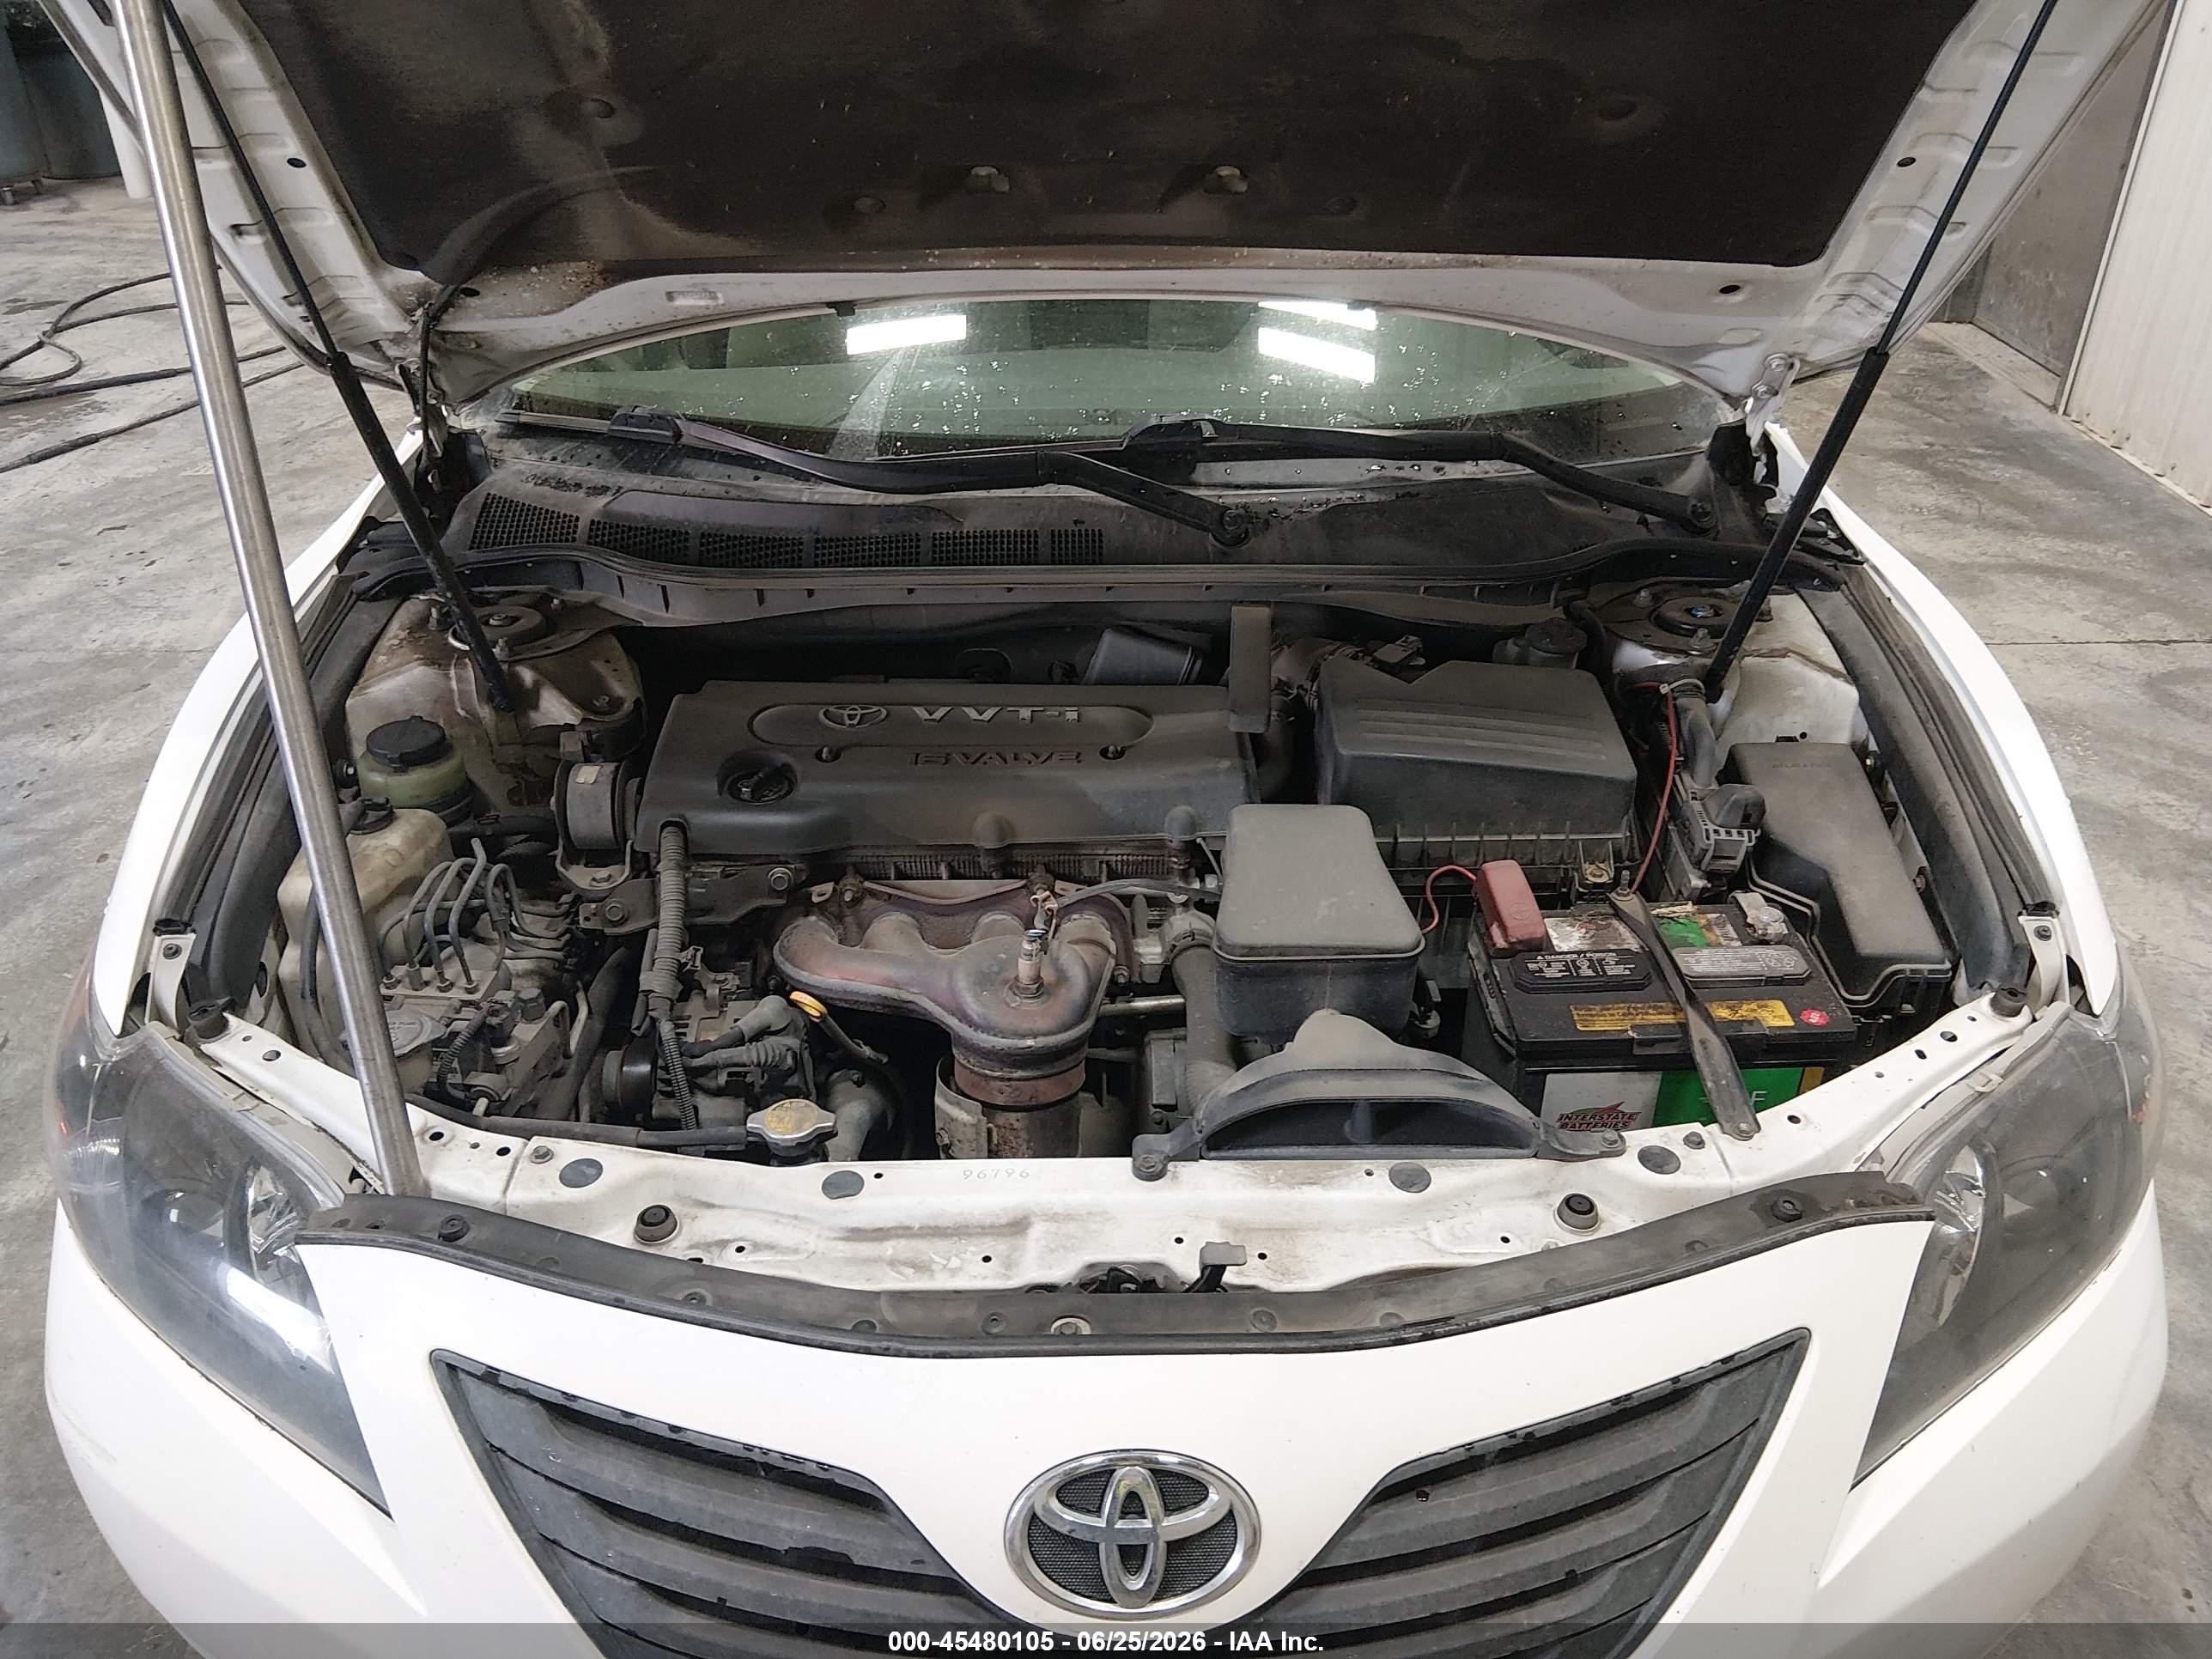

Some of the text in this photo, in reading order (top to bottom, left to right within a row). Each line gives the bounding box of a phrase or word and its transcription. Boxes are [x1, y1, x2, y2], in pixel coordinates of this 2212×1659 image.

[912, 706, 1079, 722] VVT-i
[1559, 1112, 1636, 1121] INTERSTATE
[1560, 1121, 1629, 1130] BATTERIES
[963, 1168, 1030, 1180] 96796
